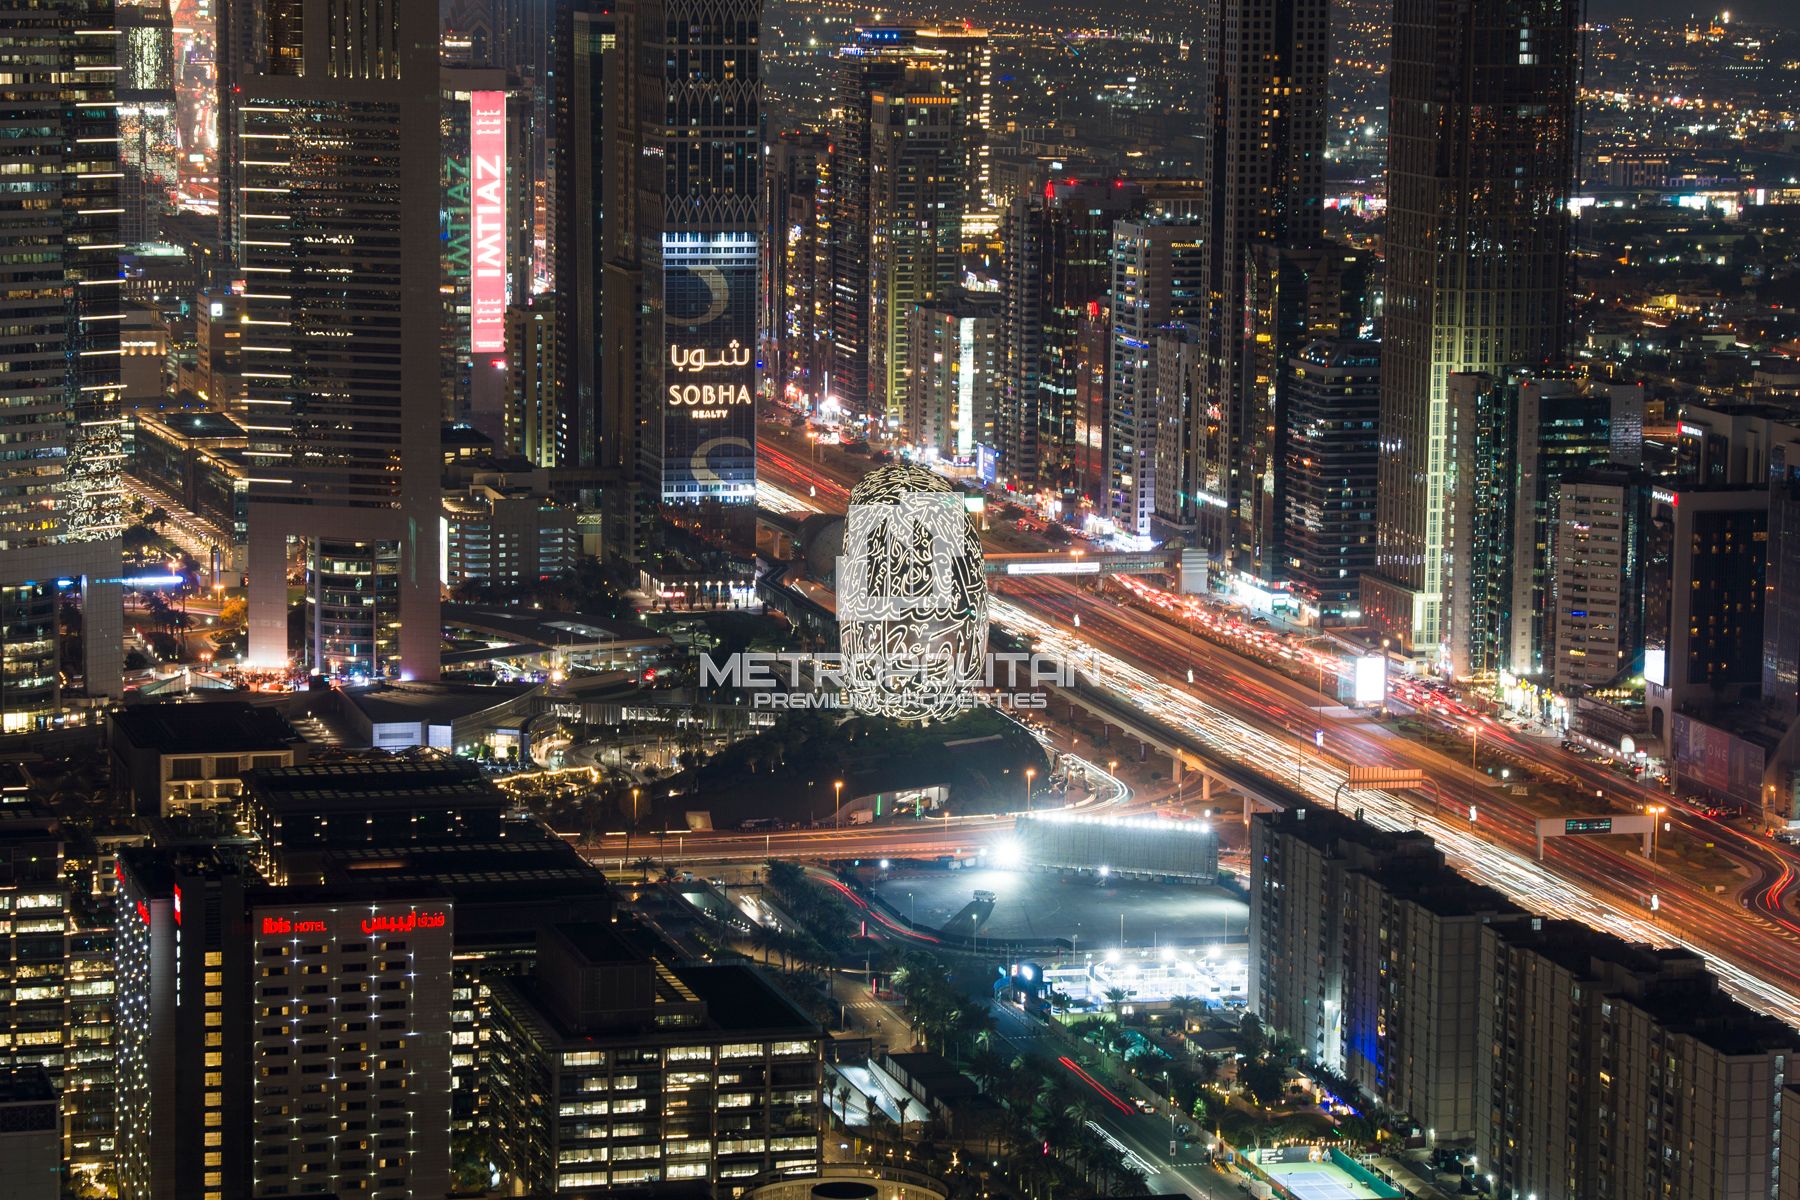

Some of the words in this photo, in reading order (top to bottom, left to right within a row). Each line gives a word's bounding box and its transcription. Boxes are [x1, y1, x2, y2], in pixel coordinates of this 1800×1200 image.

[447, 155, 470, 276] IMTIAZ
[477, 154, 501, 277] IMTIAZ
[671, 339, 750, 372] شوبا
[669, 384, 752, 406] SOBHA
[692, 409, 728, 419] REALTY
[263, 917, 291, 934] ibis
[294, 920, 327, 933] HOTEL
